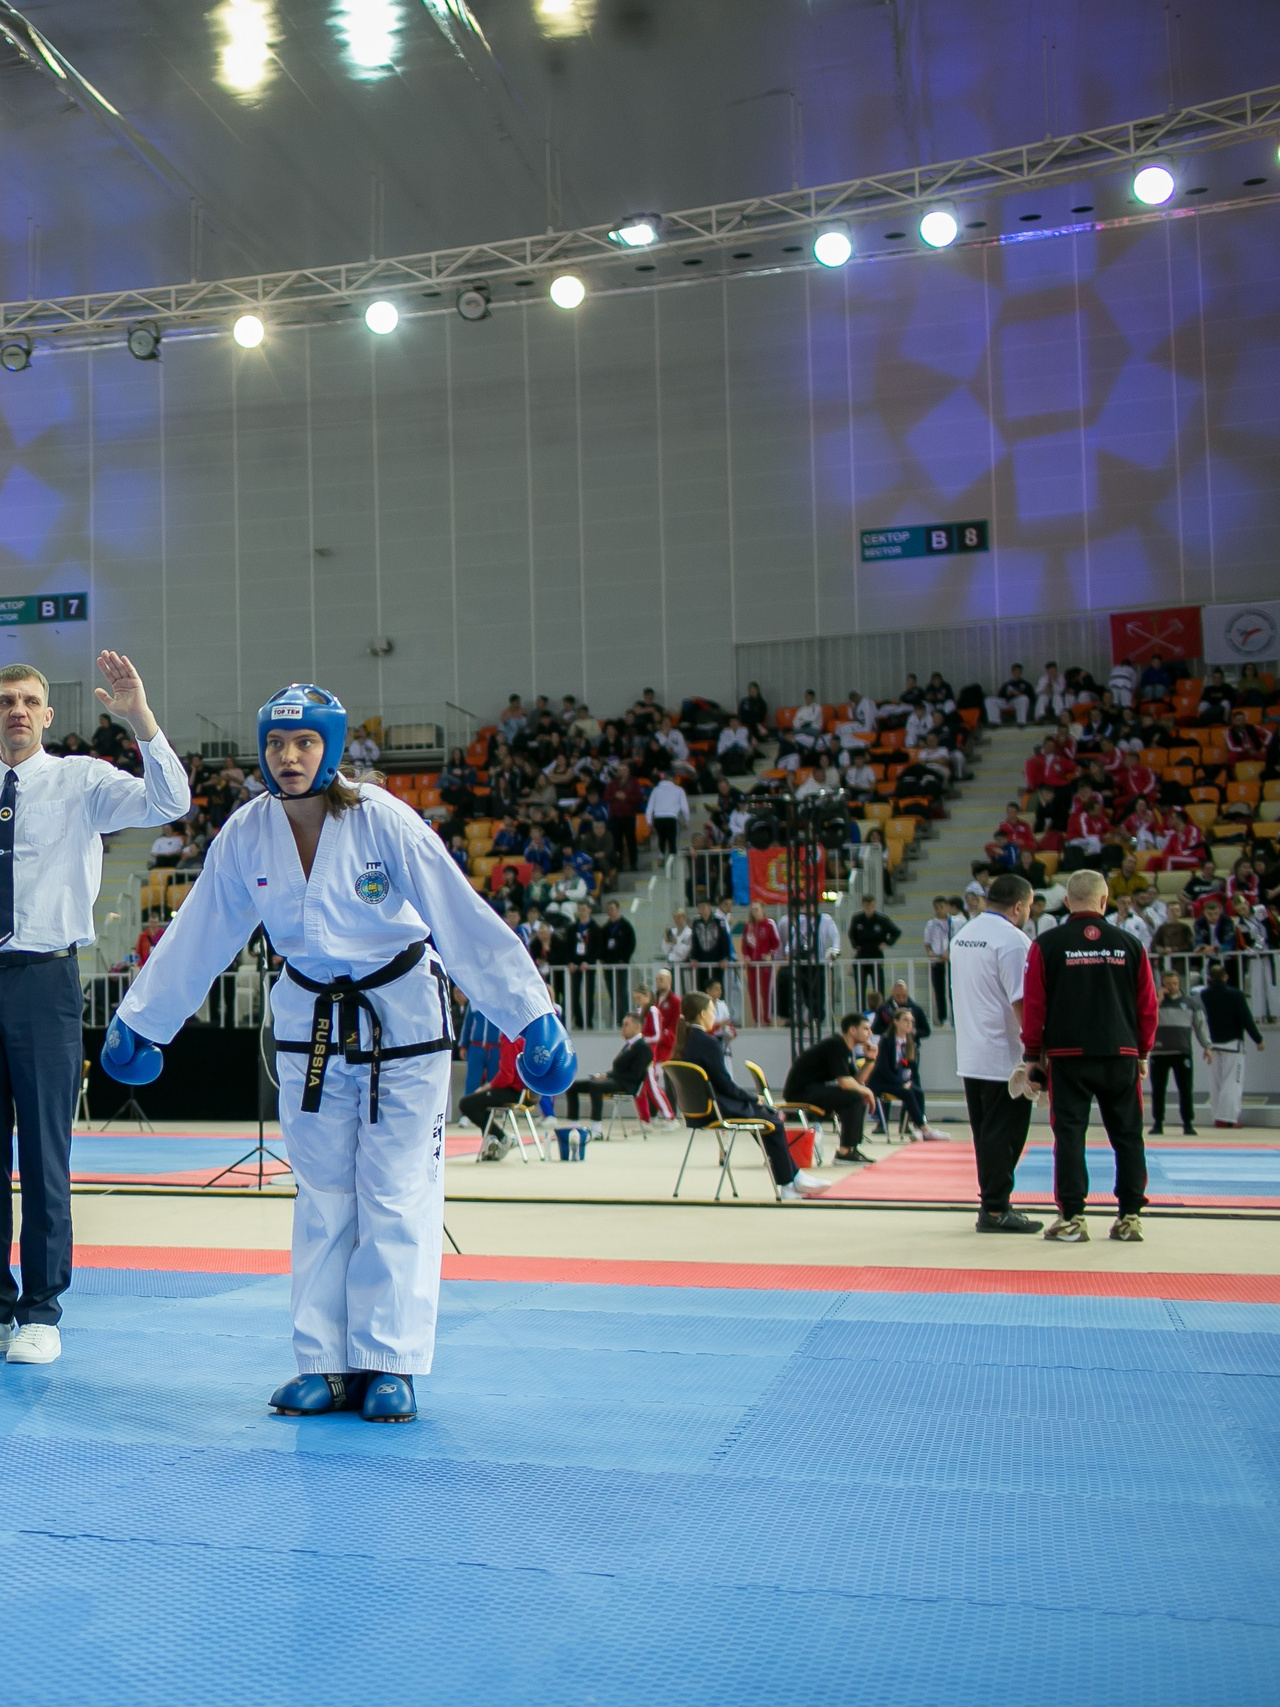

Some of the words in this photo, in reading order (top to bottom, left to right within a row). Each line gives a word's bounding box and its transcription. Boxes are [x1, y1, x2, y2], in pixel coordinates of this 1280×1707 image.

[862, 530, 910, 545] СЕКТОР
[965, 527, 978, 547] 8
[864, 546, 902, 558] SECTOR
[68, 599, 79, 615] 7
[366, 861, 382, 870] ITF
[1065, 948, 1111, 958] Taekwon-do
[1113, 949, 1125, 957] ITF
[308, 1018, 330, 1087] RUSSIA
